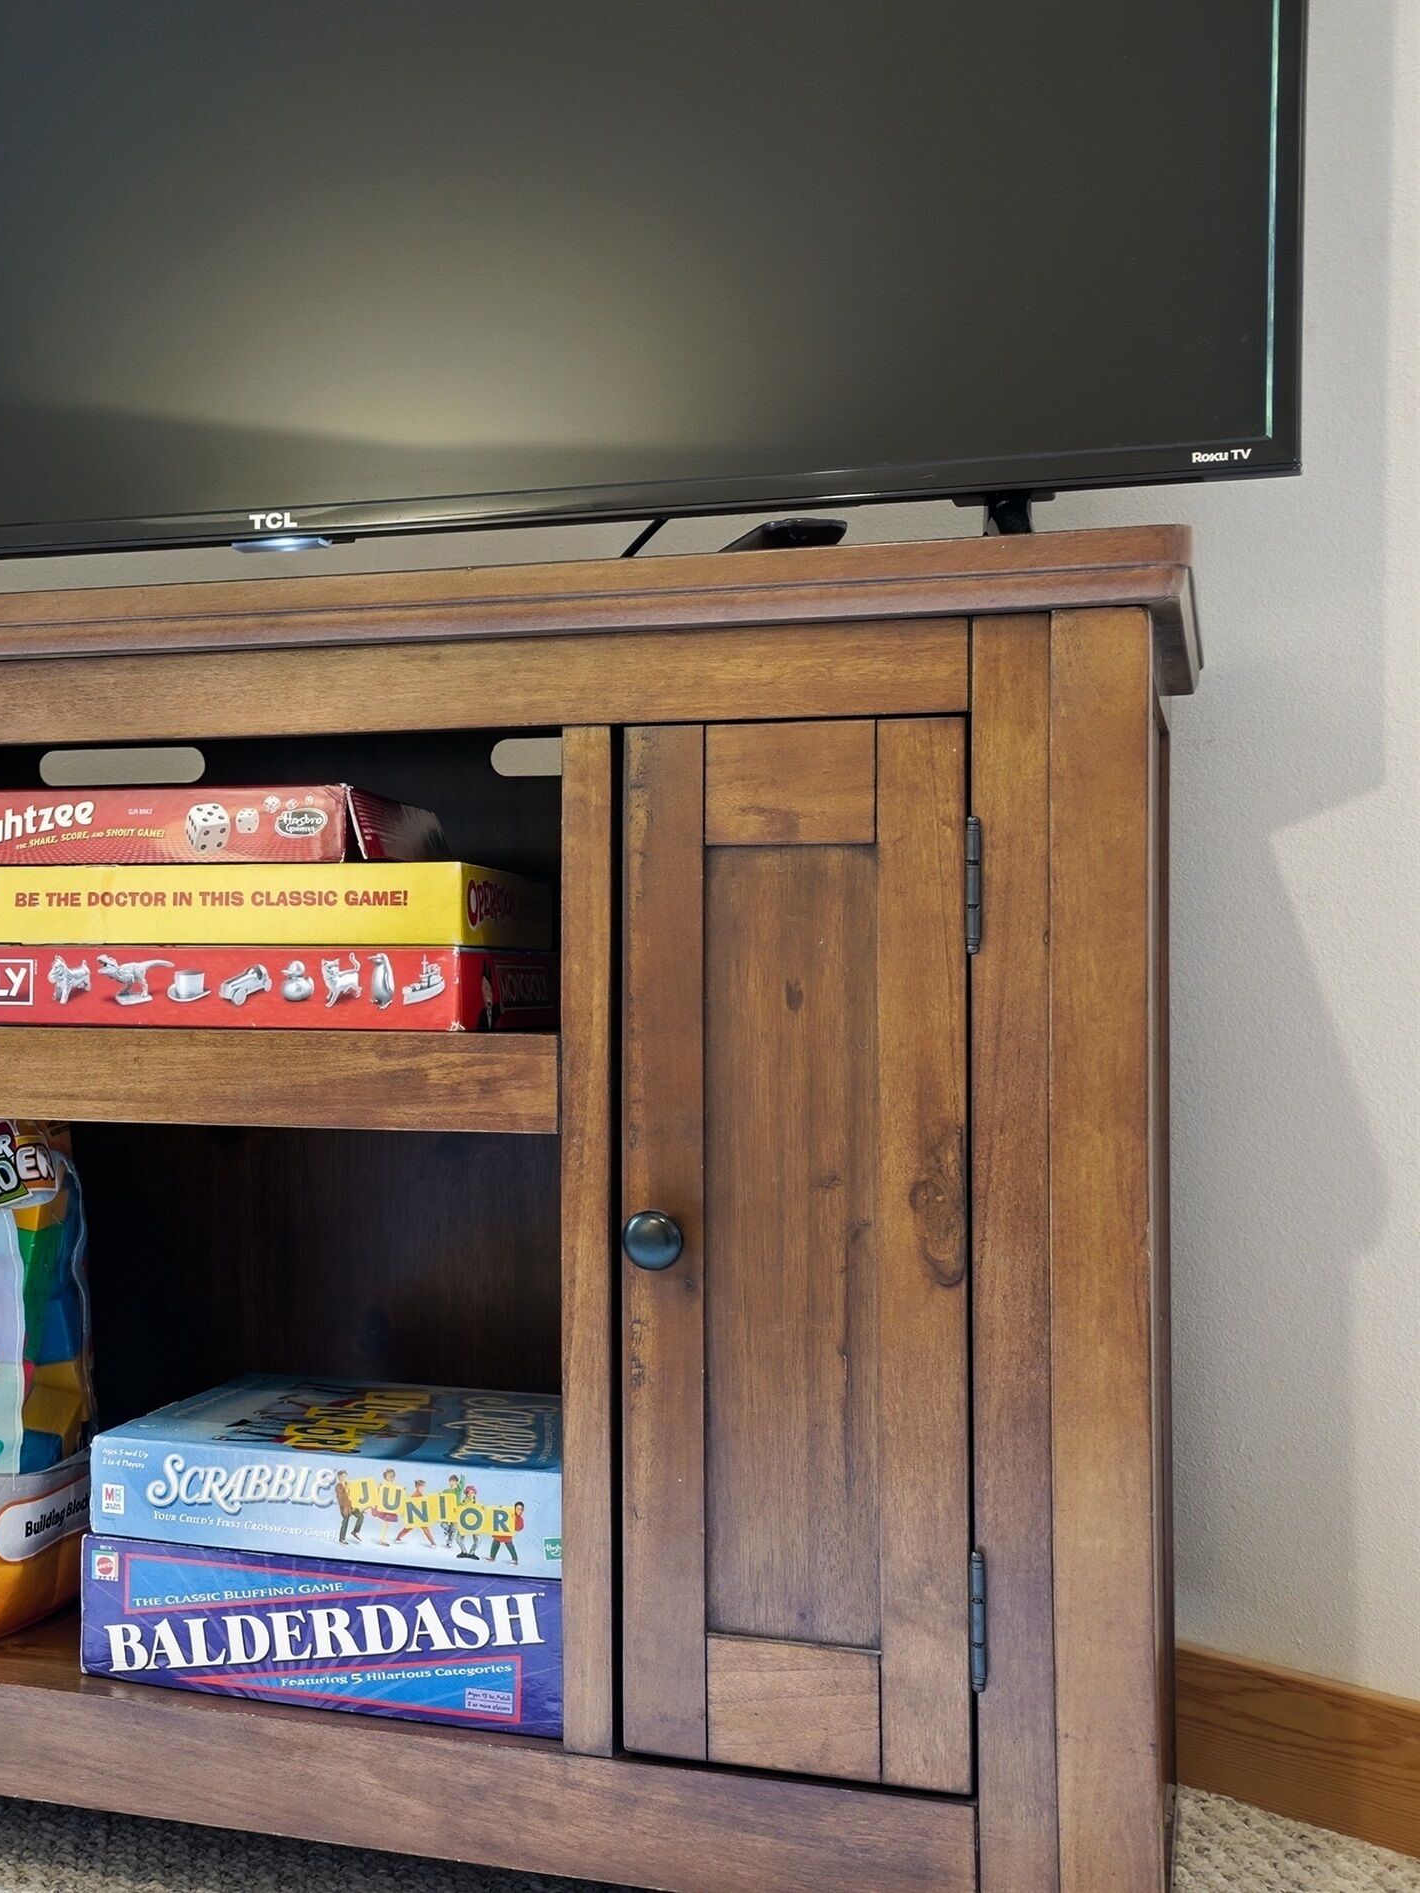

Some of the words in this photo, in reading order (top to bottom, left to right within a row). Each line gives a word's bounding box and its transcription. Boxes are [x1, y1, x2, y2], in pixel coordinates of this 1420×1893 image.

[1192, 452, 1229, 463] Roku
[1231, 448, 1252, 460] TV
[249, 512, 298, 529] TCL
[61, 831, 90, 841] SCORE,
[105, 828, 136, 838] SHOUT
[137, 829, 166, 838] GAME!
[14, 892, 40, 907] BE
[45, 892, 82, 907] THE
[87, 891, 167, 907] DOCTOR
[173, 891, 193, 906] IN
[199, 891, 245, 907] THIS
[251, 890, 338, 907] CLASSIC
[345, 890, 409, 907] GAME!
[288, 1392, 423, 1450] JUNIOR
[443, 1397, 559, 1464] SCRABBLE
[105, 1487, 122, 1502] MB
[146, 1454, 337, 1514] SCRABBLE
[358, 1481, 512, 1533] JUNIOR
[24, 1507, 66, 1538] Building
[152, 1510, 177, 1522] YOUR
[215, 1517, 241, 1529] FIRST
[244, 1520, 302, 1536] CROSSWORD
[132, 1596, 162, 1607] THE
[165, 1592, 221, 1605] CLASSIC
[223, 1587, 294, 1600] BLUFFING
[298, 1582, 344, 1594] GAME
[104, 1592, 546, 1672] BALDERDASH
[281, 1674, 348, 1688] Featuring
[351, 1673, 363, 1684] 5
[366, 1668, 432, 1682] Hilarious
[435, 1664, 513, 1679] Categories
